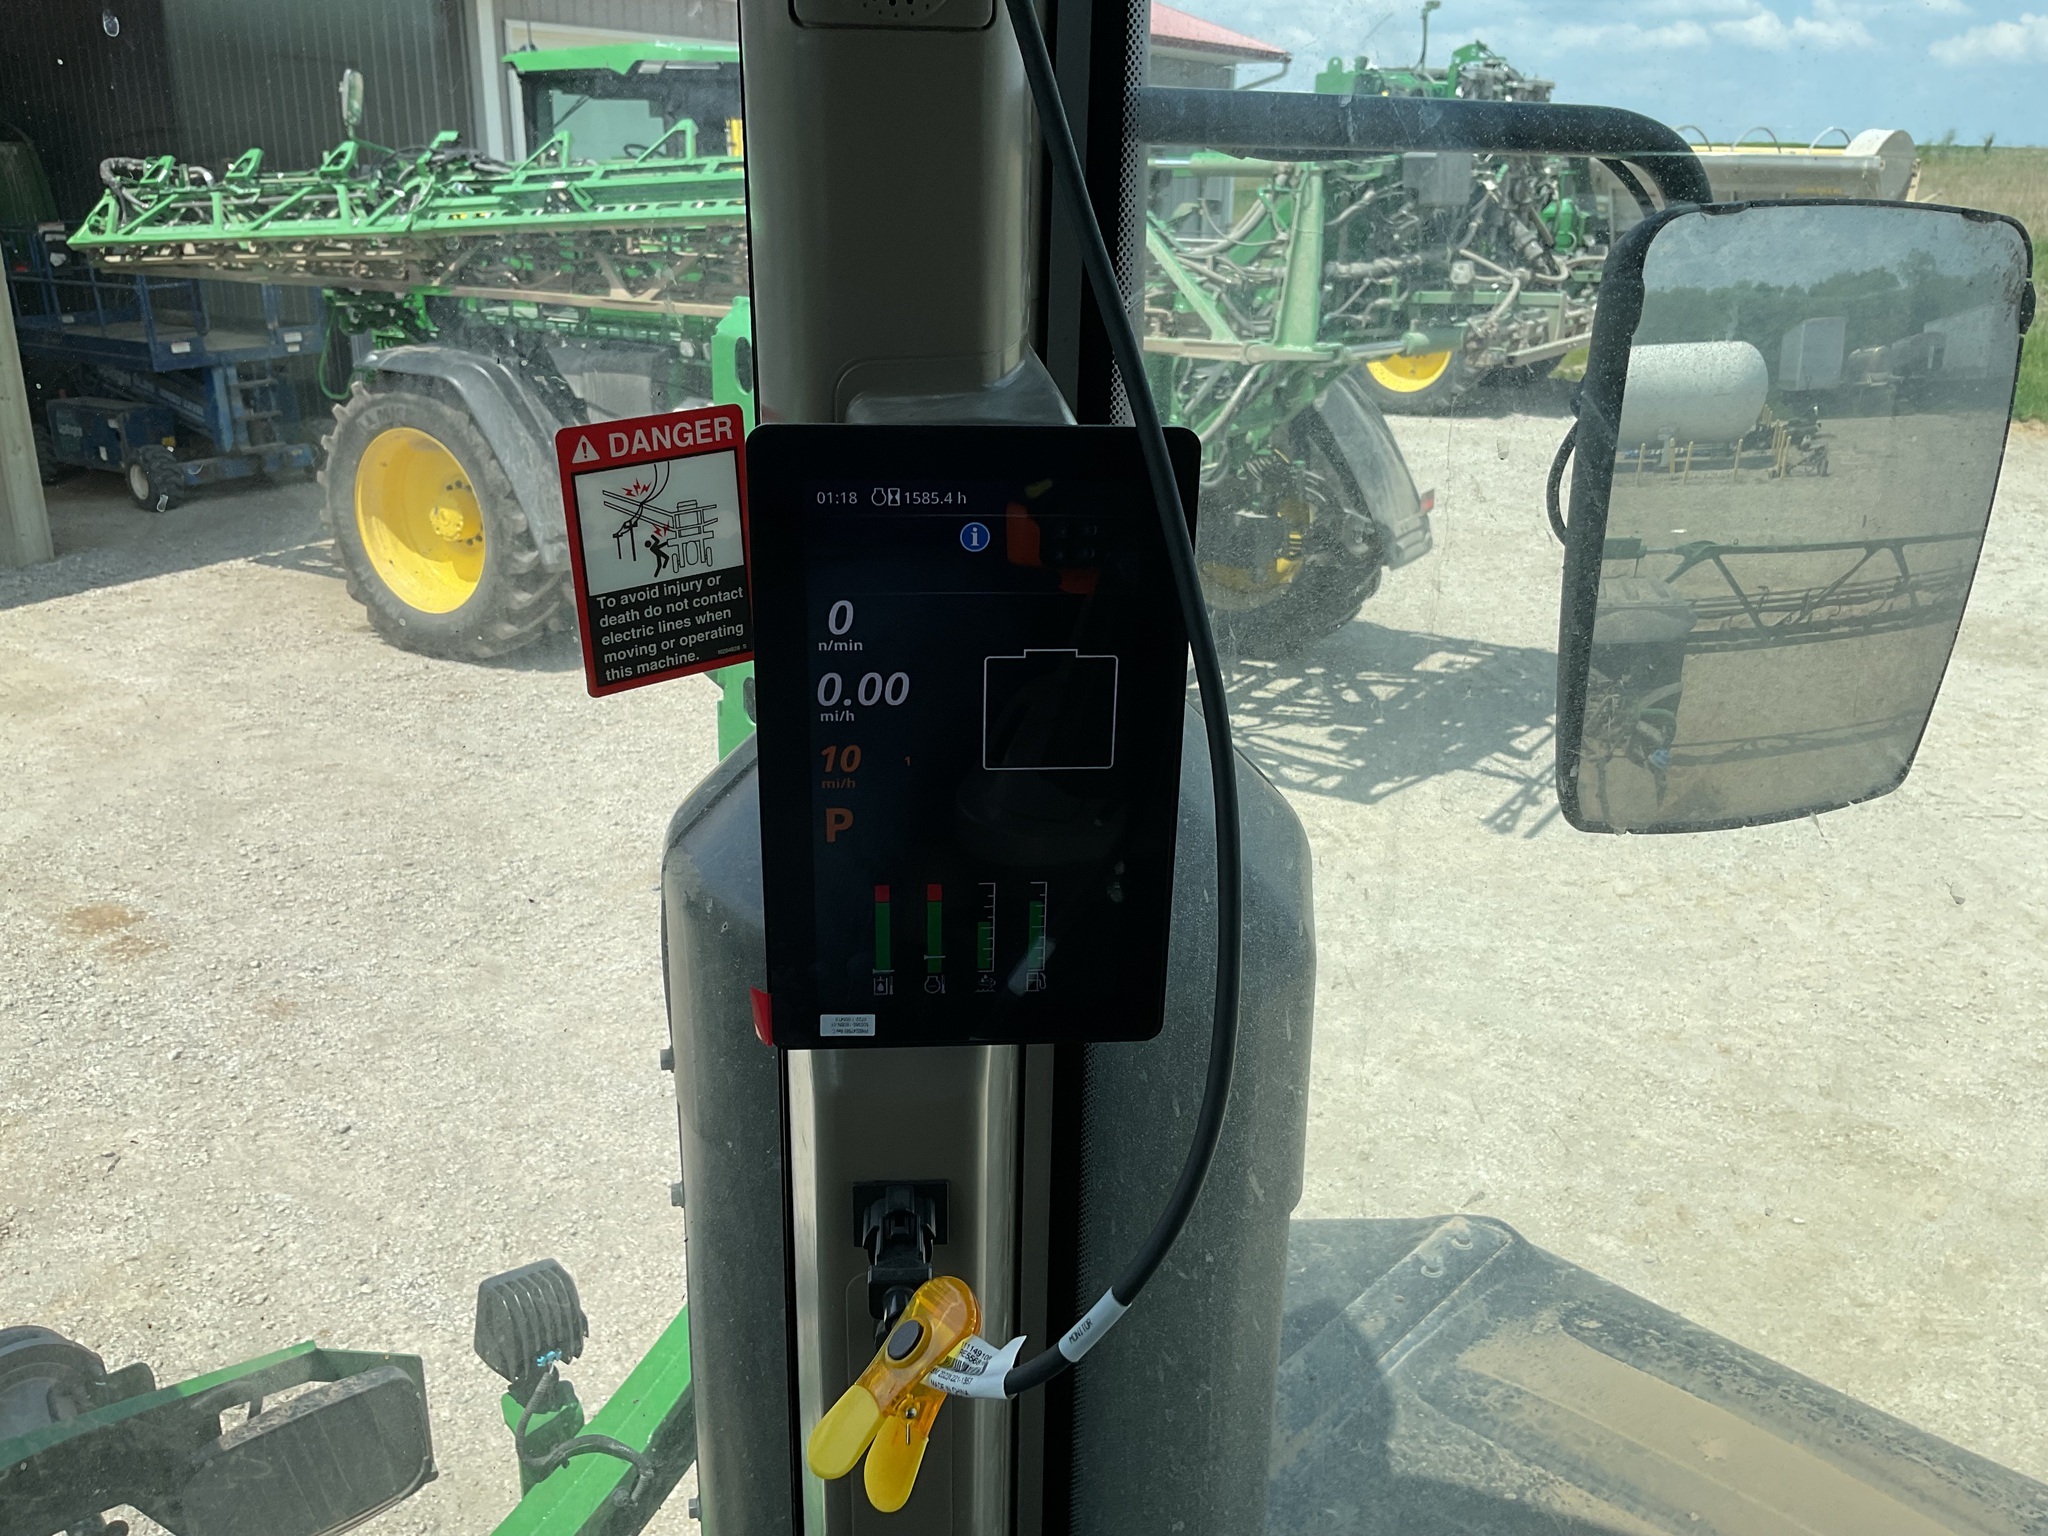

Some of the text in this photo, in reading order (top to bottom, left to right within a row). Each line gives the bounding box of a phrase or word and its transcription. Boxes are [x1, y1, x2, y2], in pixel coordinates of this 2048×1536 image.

[608, 416, 733, 458] DANGER
[816, 491, 858, 505] 01:18
[904, 491, 967, 505] 1585.4 h
[596, 575, 722, 609] To avoid injury or
[599, 586, 744, 627] death do not contact
[601, 609, 732, 646] electric lines when
[828, 599, 854, 636] 0
[604, 624, 744, 664] moving or operating
[818, 639, 863, 651] n/min
[605, 652, 700, 682] this machine.
[817, 671, 910, 707] 0.00
[820, 710, 855, 722] mi/h
[820, 744, 862, 773] 10
[904, 755, 911, 766] 1
[821, 777, 856, 789] mi/h
[825, 807, 854, 843] P
[1068, 1317, 1094, 1344] MONITOR
